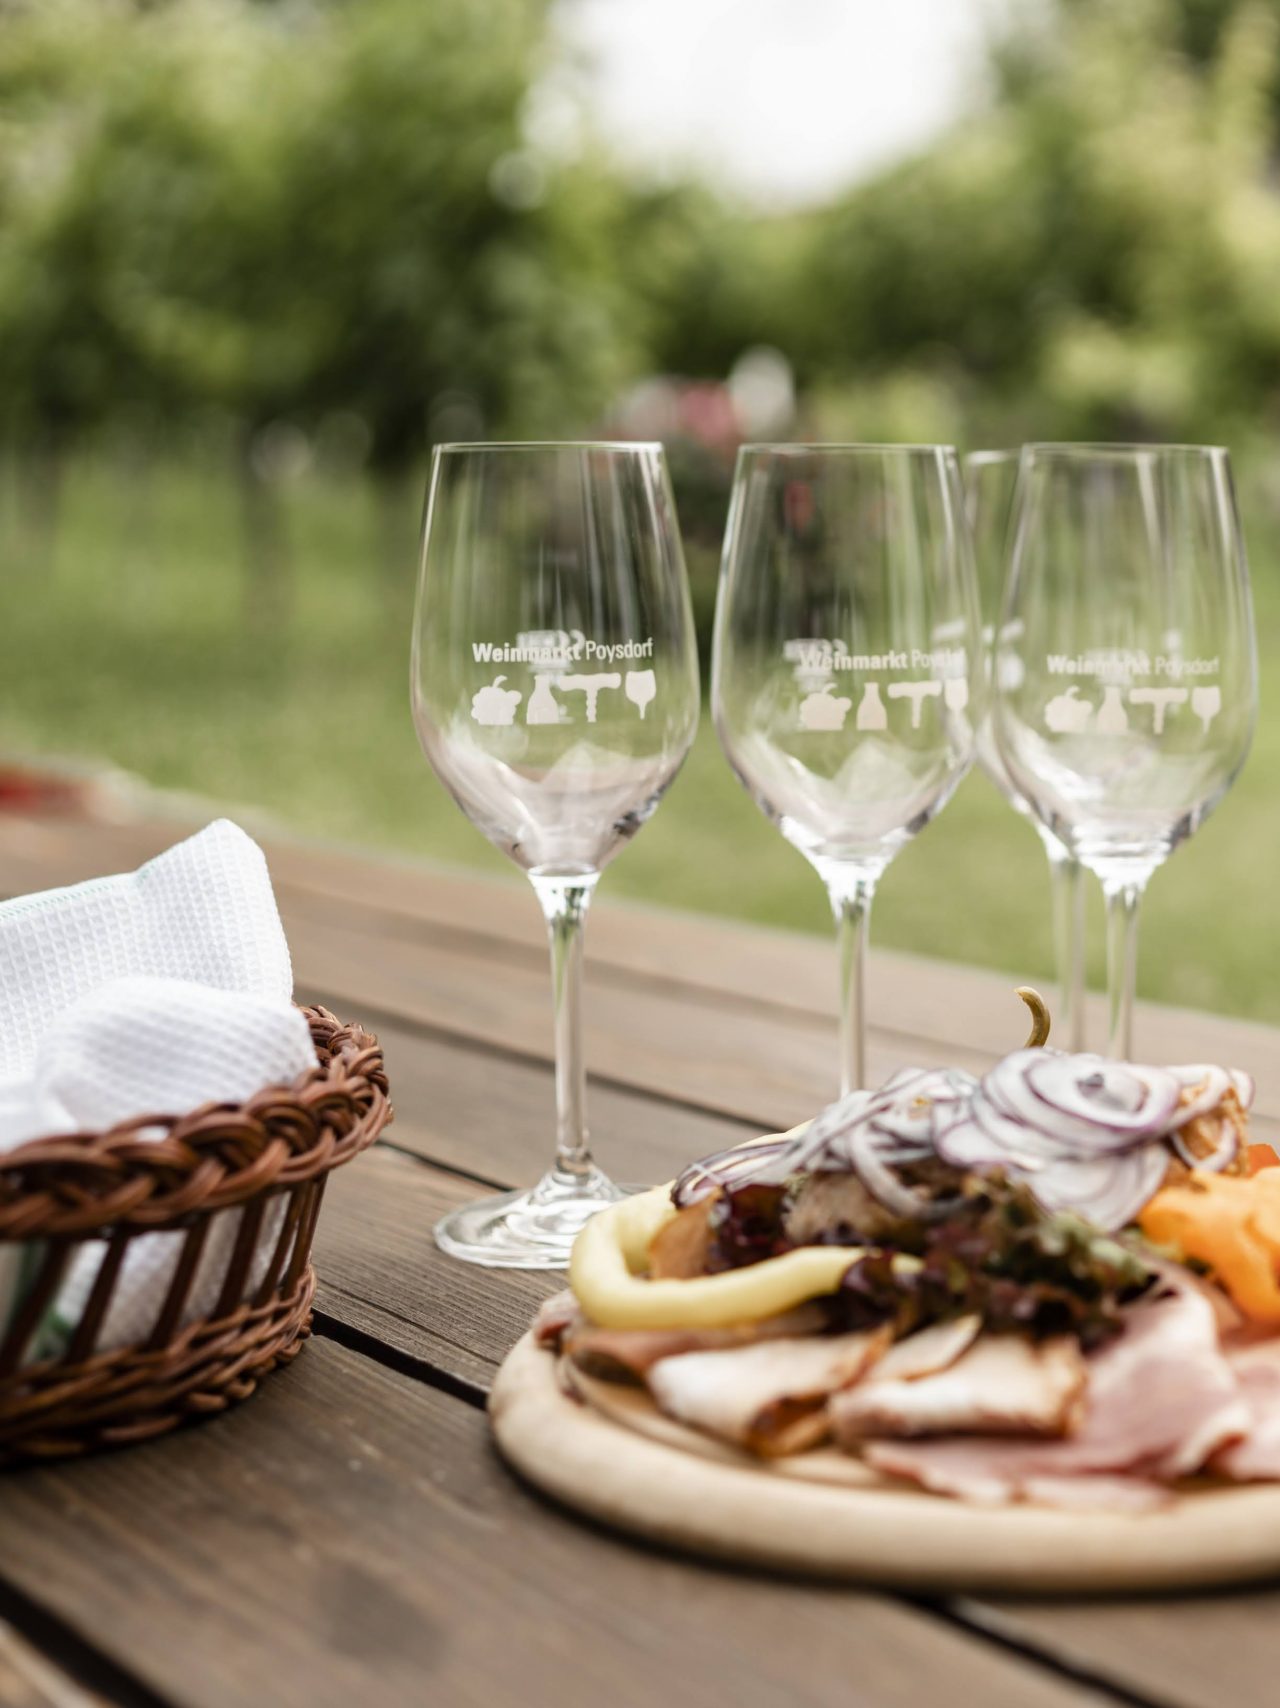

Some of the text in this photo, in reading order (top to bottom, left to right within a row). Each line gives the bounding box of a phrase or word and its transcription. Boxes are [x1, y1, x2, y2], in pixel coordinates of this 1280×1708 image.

[472, 637, 653, 664] Weinmarkt Poysdorf
[799, 650, 908, 671] Weinmarkt
[1046, 653, 1151, 675] Weinkt
